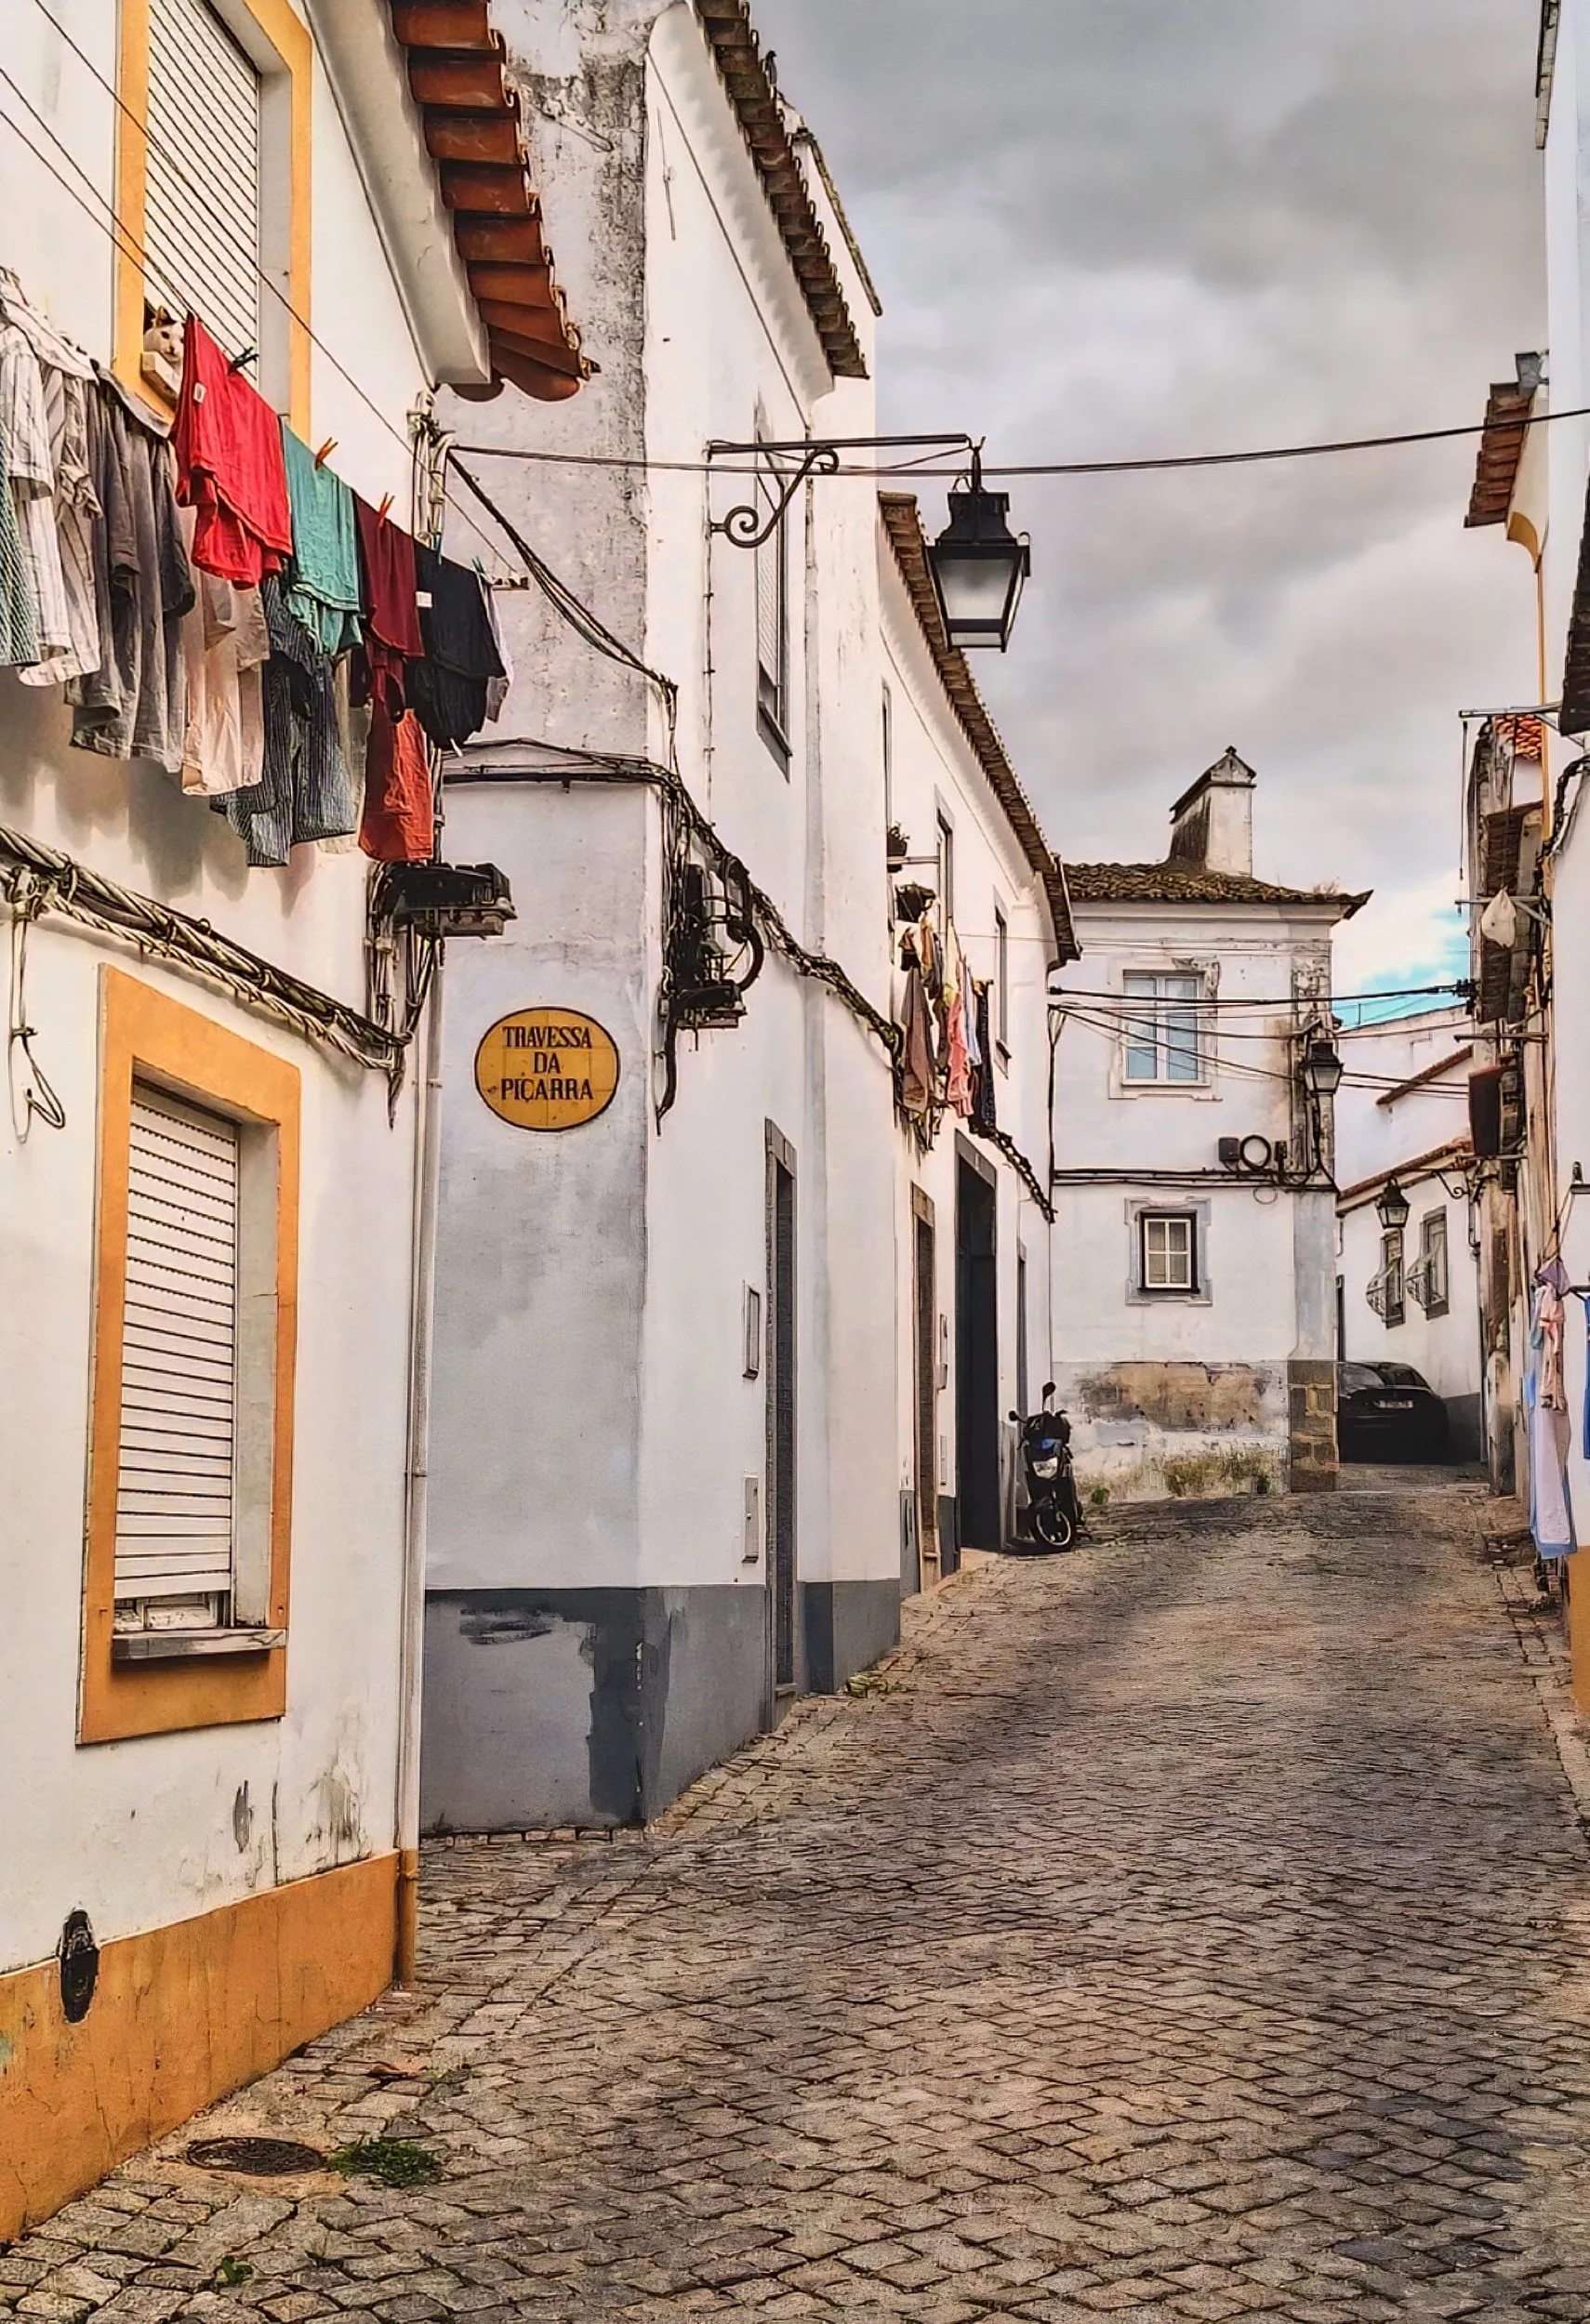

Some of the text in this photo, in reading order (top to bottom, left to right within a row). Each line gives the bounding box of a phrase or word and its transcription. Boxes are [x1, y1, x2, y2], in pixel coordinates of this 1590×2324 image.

[502, 1025, 592, 1049] TRAVESSA
[534, 1051, 561, 1074] DA
[501, 1078, 593, 1103] PIÇARRA
